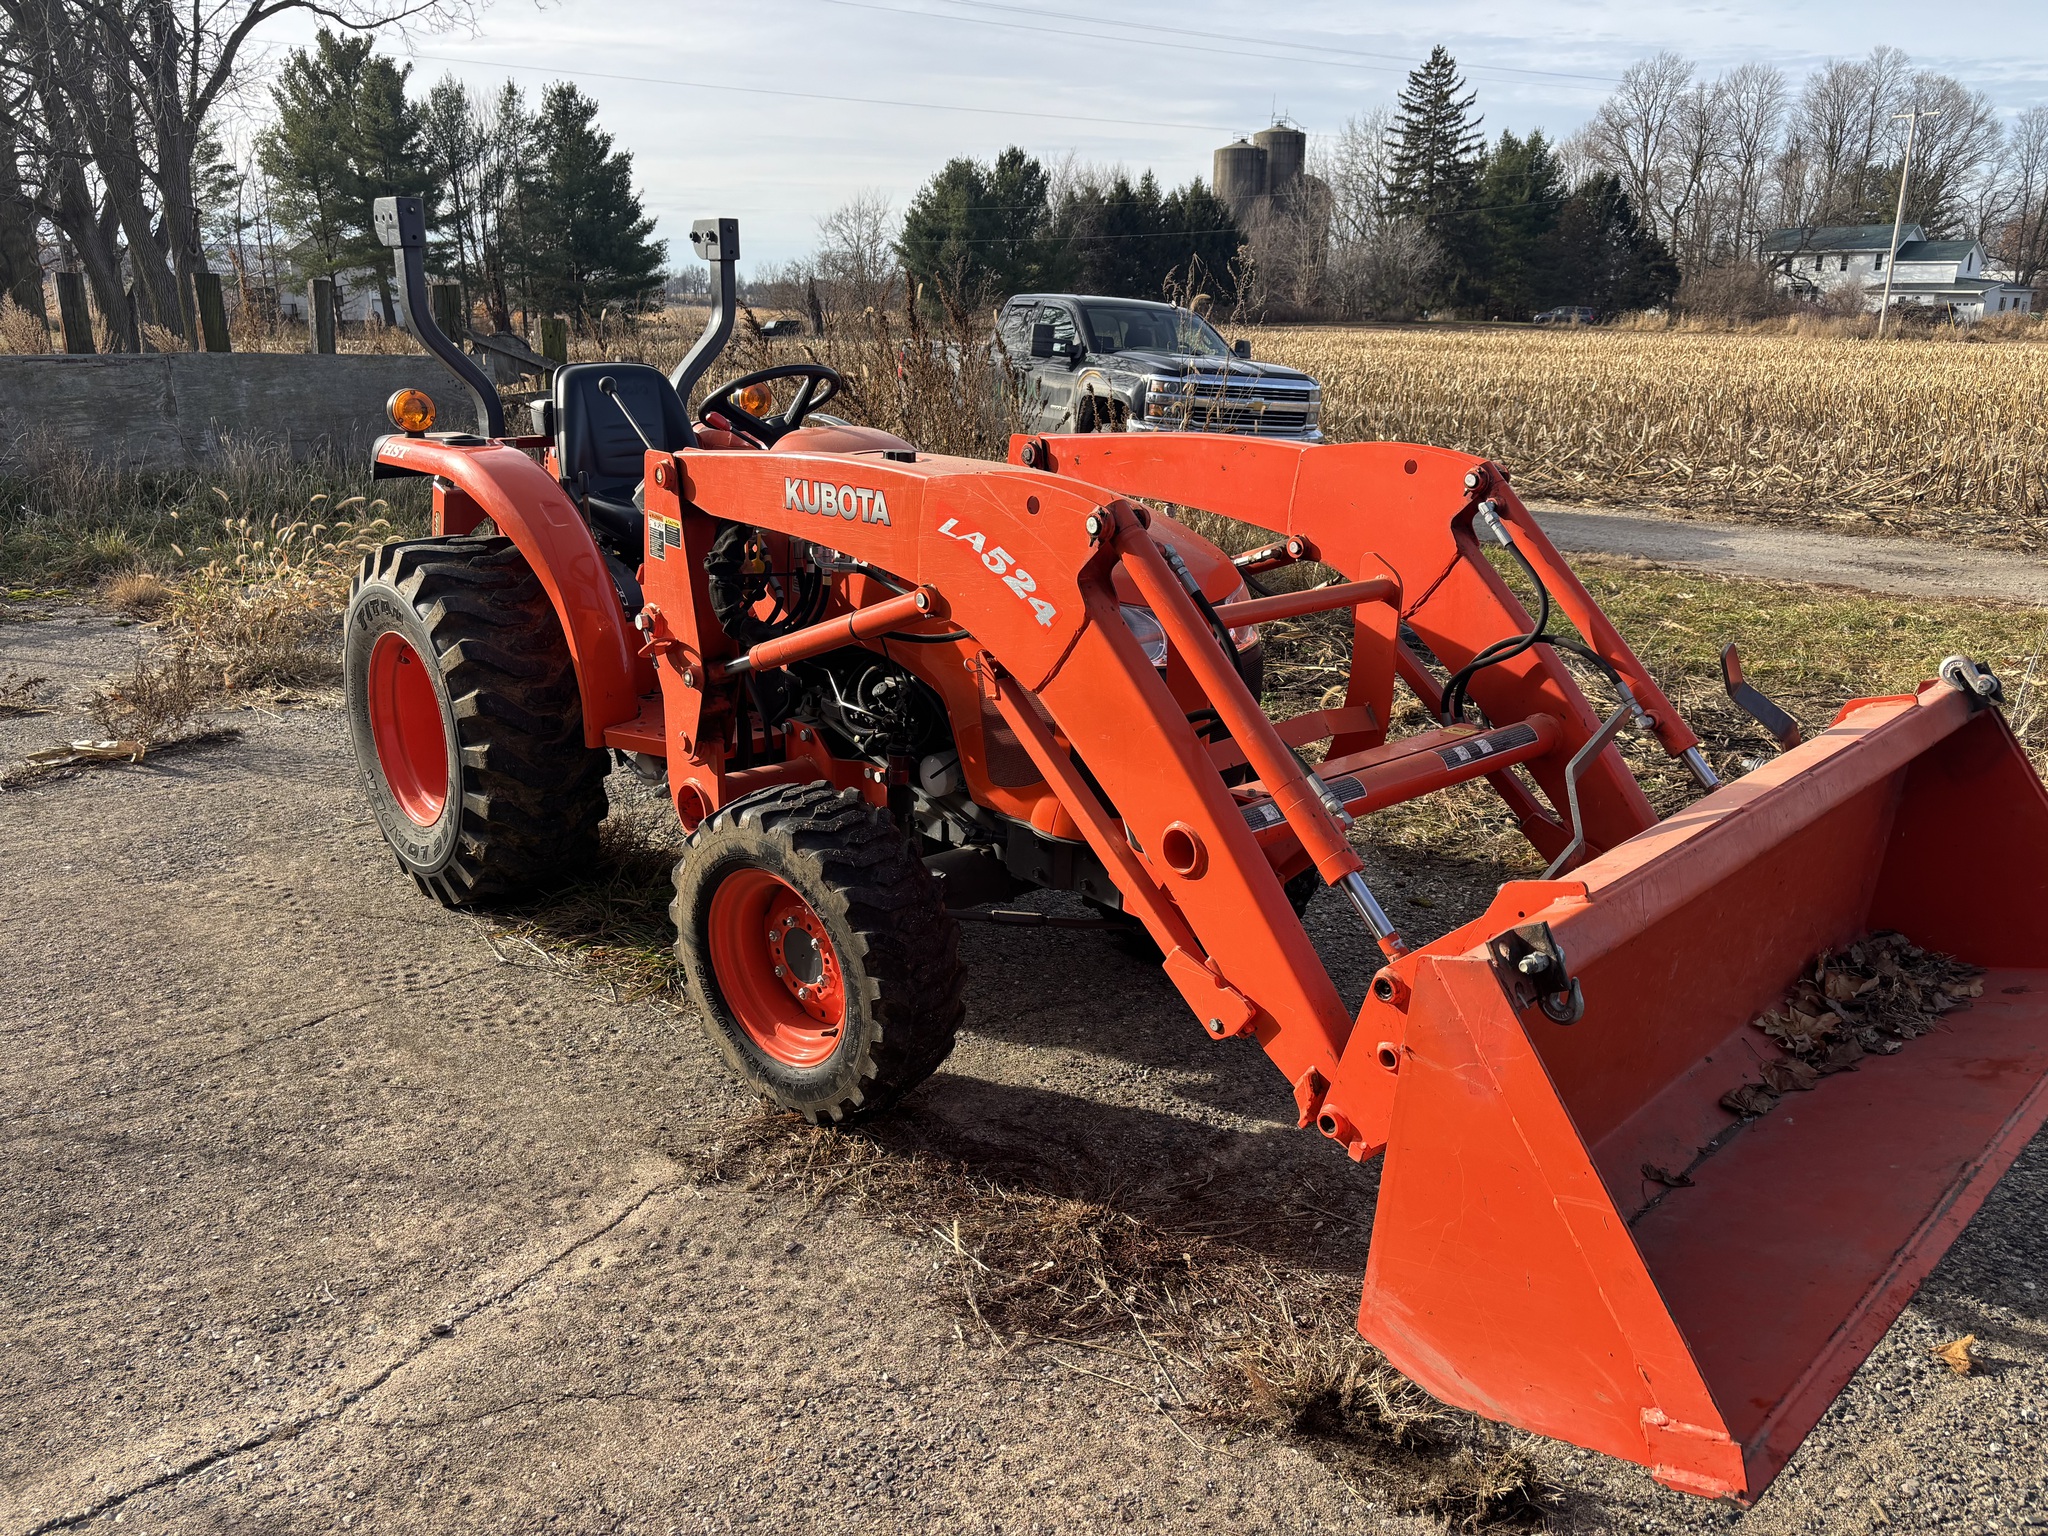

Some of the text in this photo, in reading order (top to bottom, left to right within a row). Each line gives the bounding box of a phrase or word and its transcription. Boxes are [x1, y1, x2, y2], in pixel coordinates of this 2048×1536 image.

[381, 443, 411, 459] HST
[784, 477, 891, 527] KUBOTA
[938, 517, 1057, 628] LA524
[357, 598, 404, 632] TITAN
